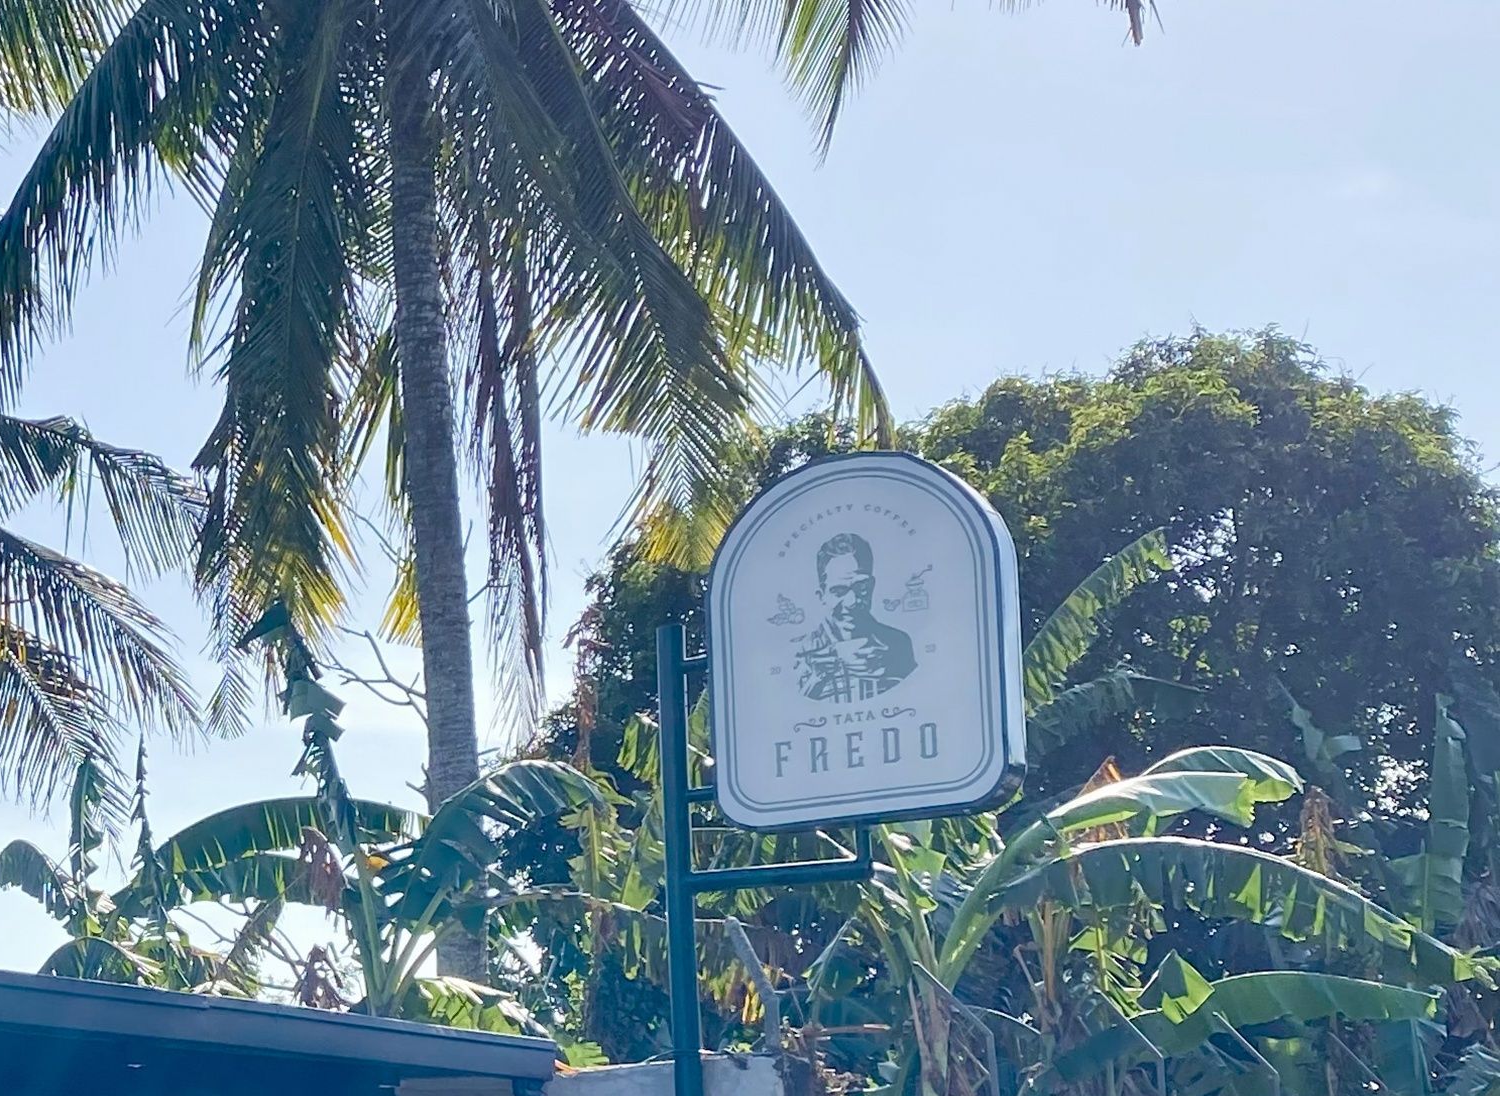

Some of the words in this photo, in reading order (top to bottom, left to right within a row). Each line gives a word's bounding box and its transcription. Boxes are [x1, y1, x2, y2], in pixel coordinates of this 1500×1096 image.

[778, 504, 853, 557] SPECIALTY
[864, 504, 916, 536] COFFEE
[833, 710, 876, 725] TATA
[774, 722, 939, 778] FREDO
